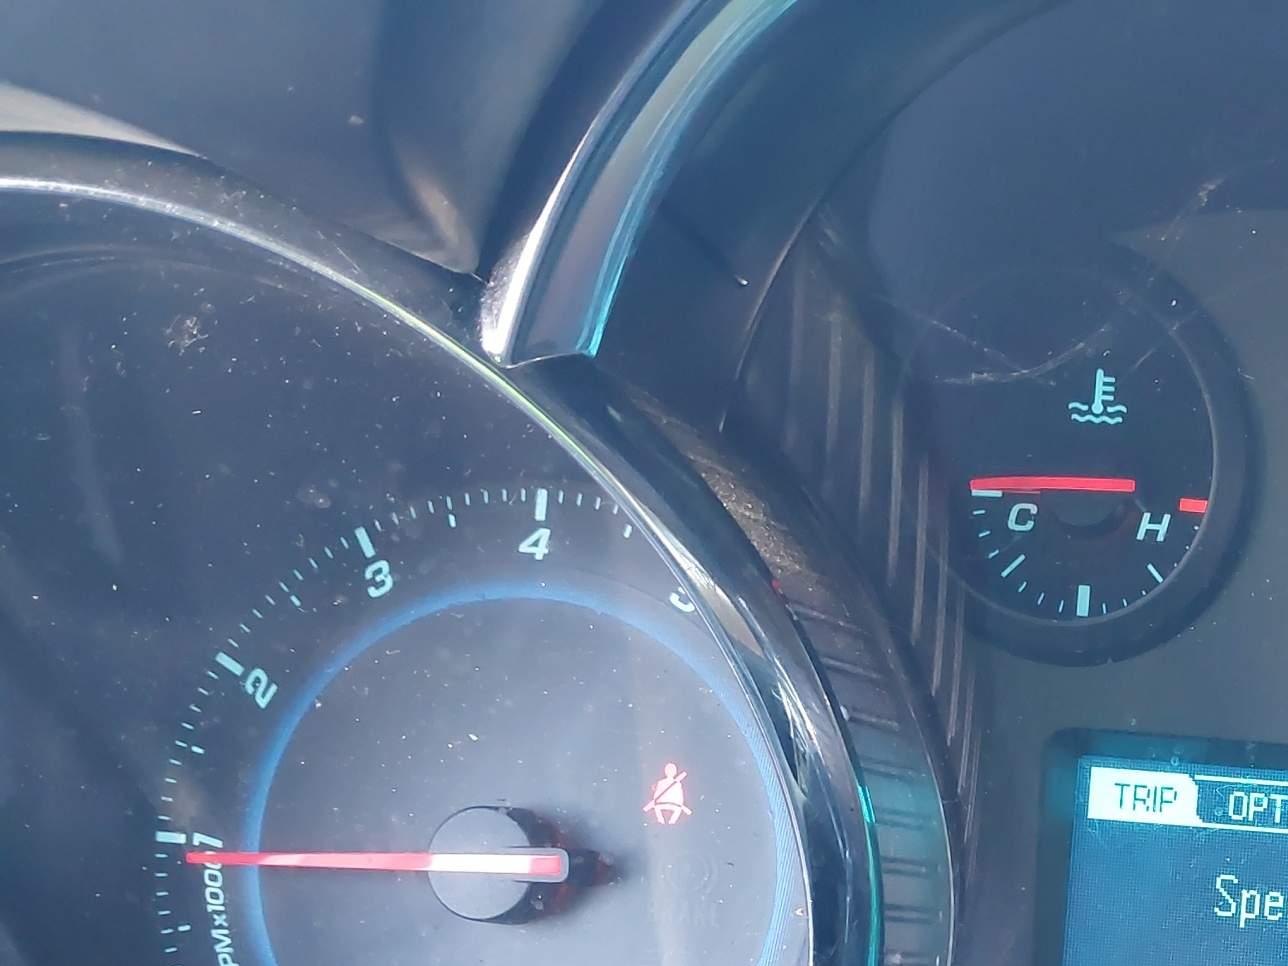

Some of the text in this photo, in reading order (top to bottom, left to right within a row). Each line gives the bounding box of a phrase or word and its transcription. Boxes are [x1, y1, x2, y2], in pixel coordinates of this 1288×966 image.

[1007, 503, 1038, 532] C
[1136, 512, 1171, 543] H
[518, 529, 550, 560] 4
[365, 561, 393, 597] 3
[245, 668, 278, 708] 2
[1114, 782, 1178, 813] TRIP
